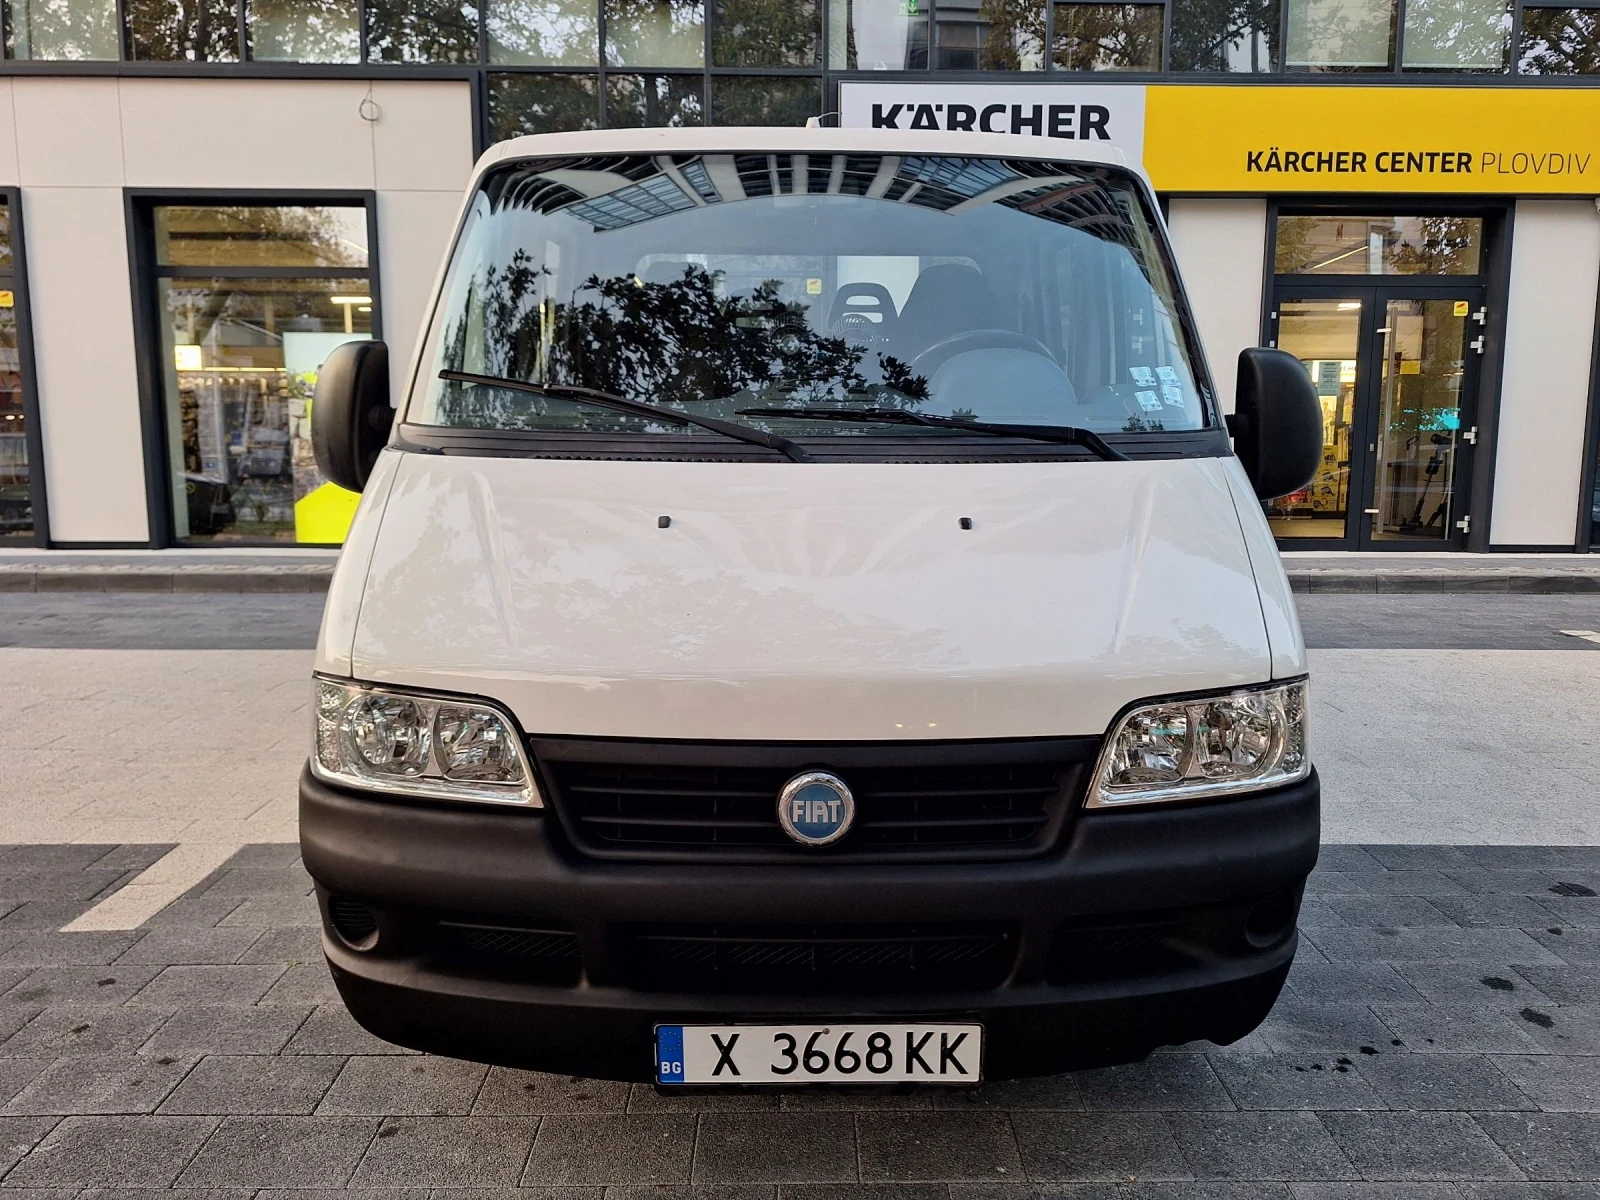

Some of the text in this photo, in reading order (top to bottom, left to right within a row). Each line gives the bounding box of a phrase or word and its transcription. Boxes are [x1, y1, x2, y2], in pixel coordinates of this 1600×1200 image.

[872, 103, 1112, 140] KÄRCHER
[1246, 146, 1591, 174] KÄRCHER CENTER PLOVDIV
[792, 800, 841, 823] FIAT
[661, 1061, 682, 1075] BG
[710, 1033, 741, 1076] X
